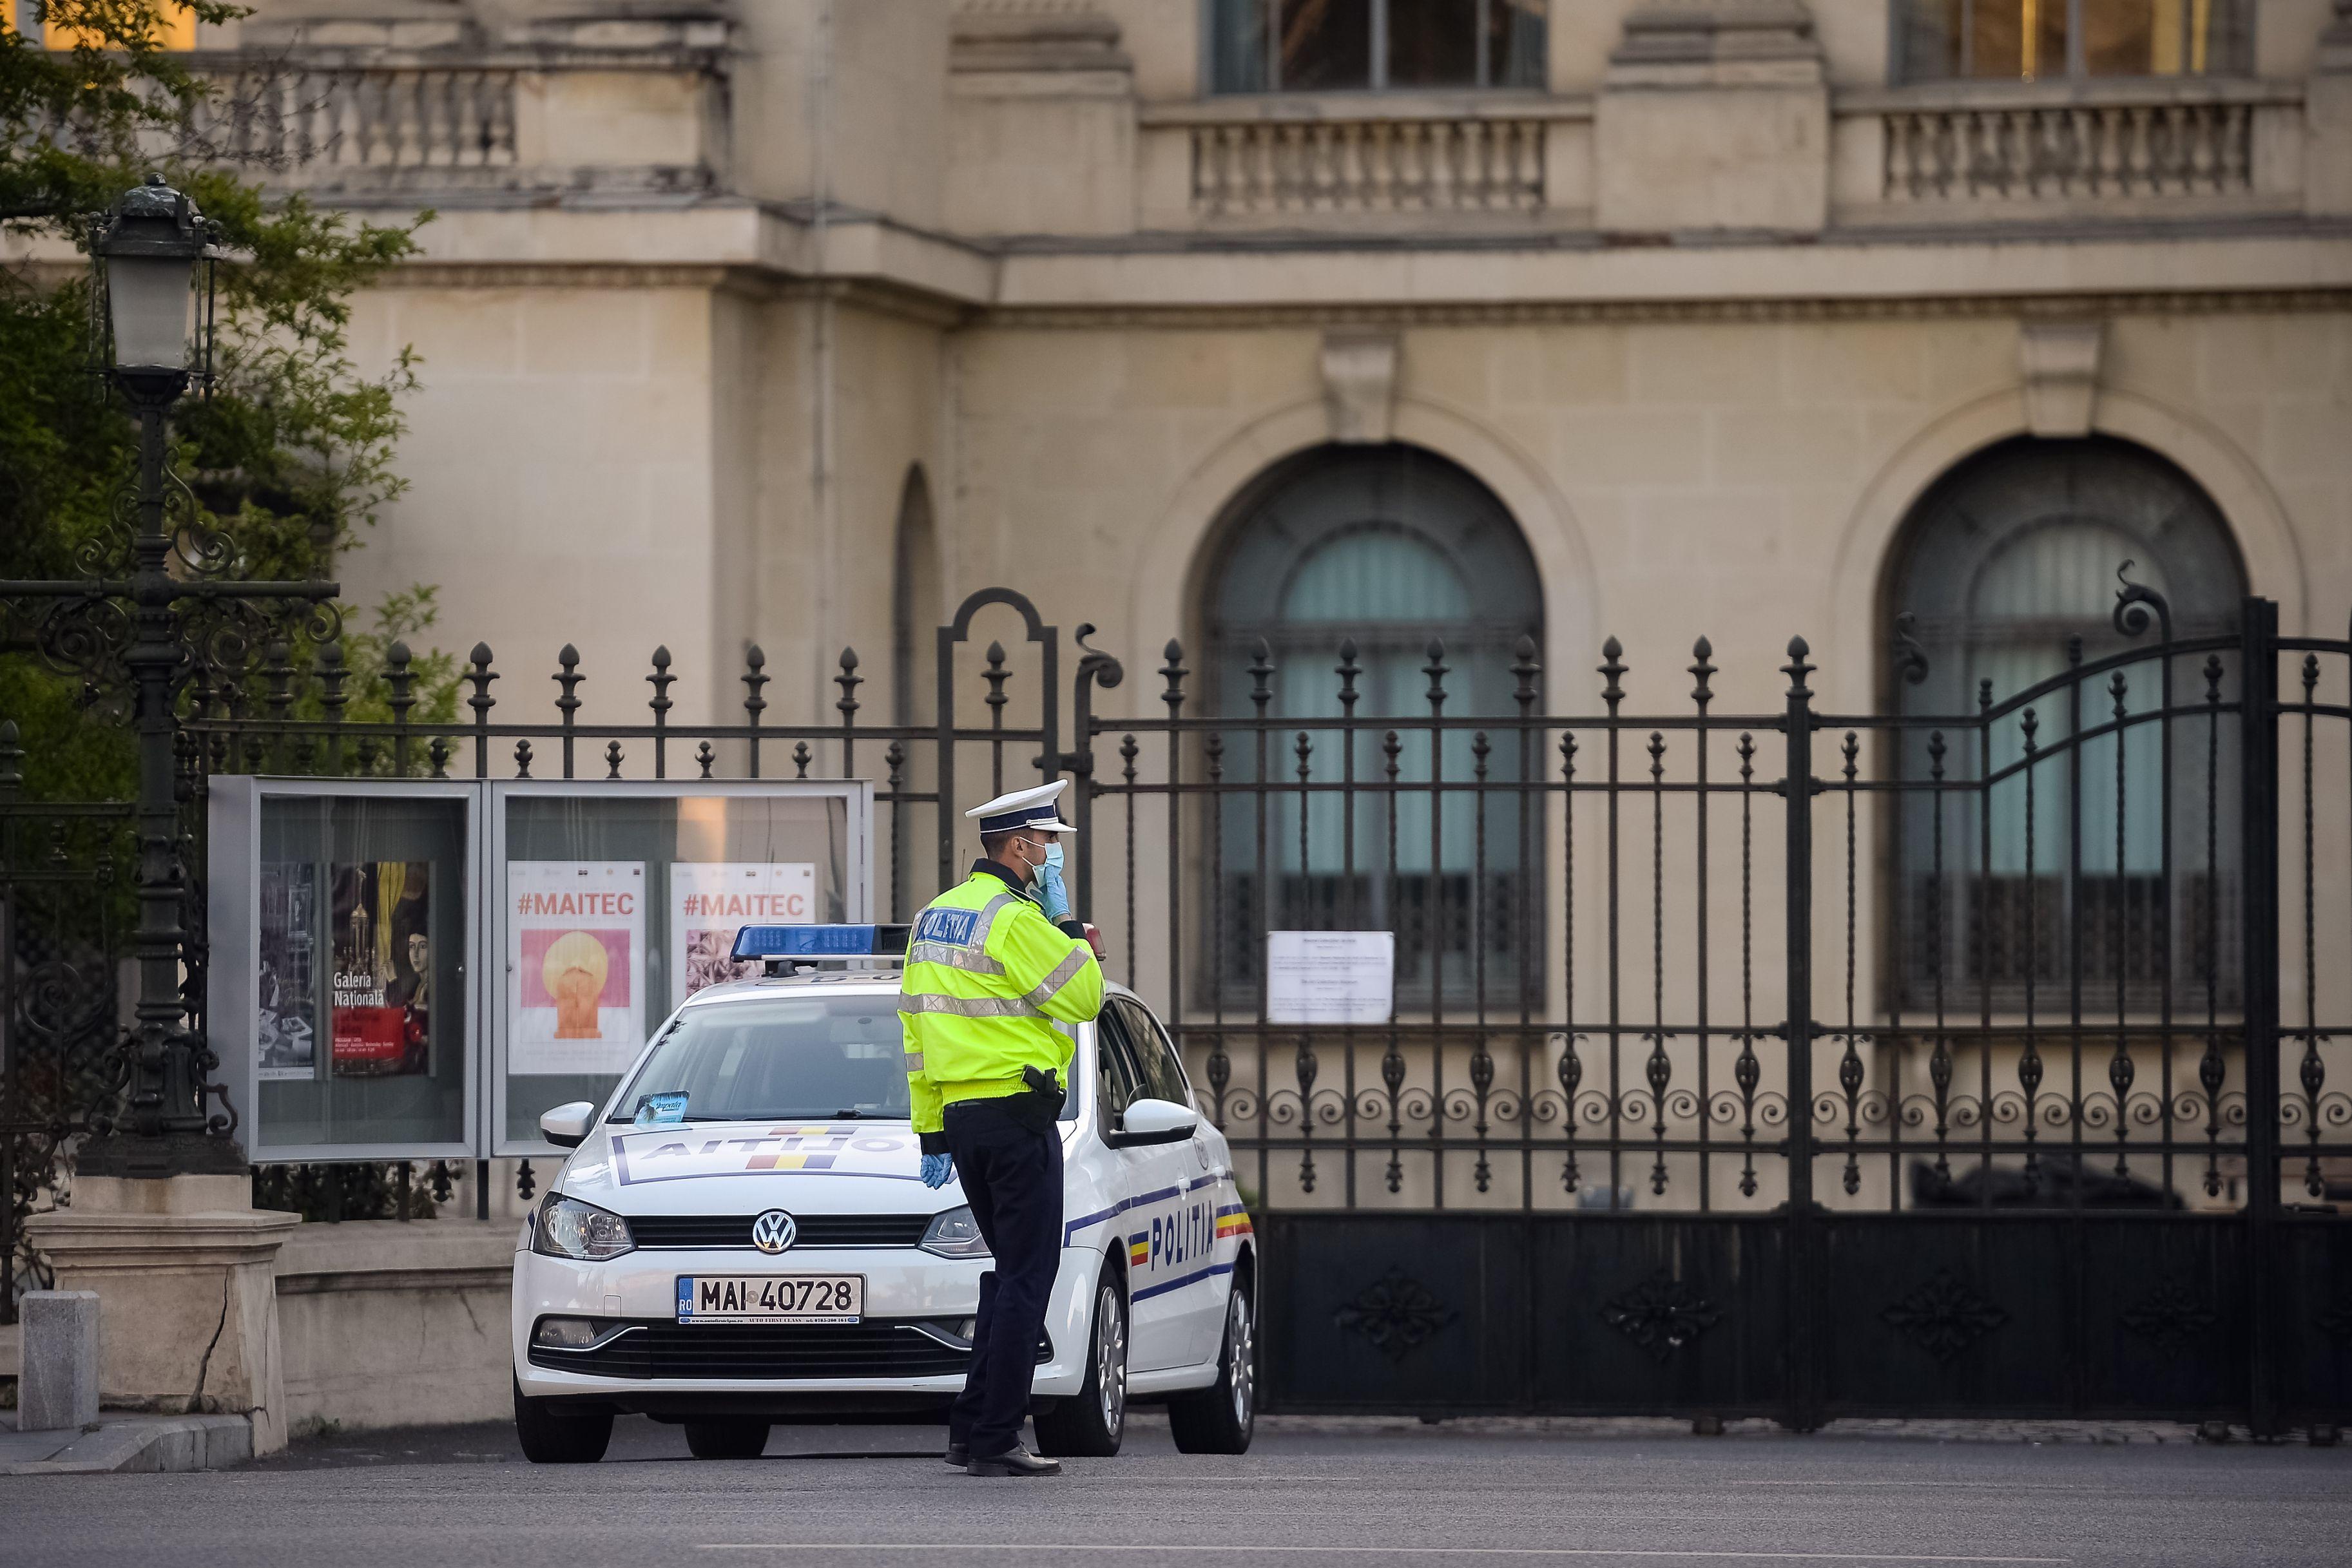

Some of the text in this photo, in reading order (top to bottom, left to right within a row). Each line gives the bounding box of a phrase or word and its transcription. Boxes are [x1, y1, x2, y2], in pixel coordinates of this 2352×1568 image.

[517, 892, 634, 915] #MAITEC
[683, 893, 804, 916] #MAITEC
[333, 971, 372, 988] Galeria
[334, 989, 385, 1010] Națională
[1151, 1200, 1213, 1271] POLITIA
[680, 1299, 692, 1311] RO
[701, 1281, 852, 1311] MAI 40728
